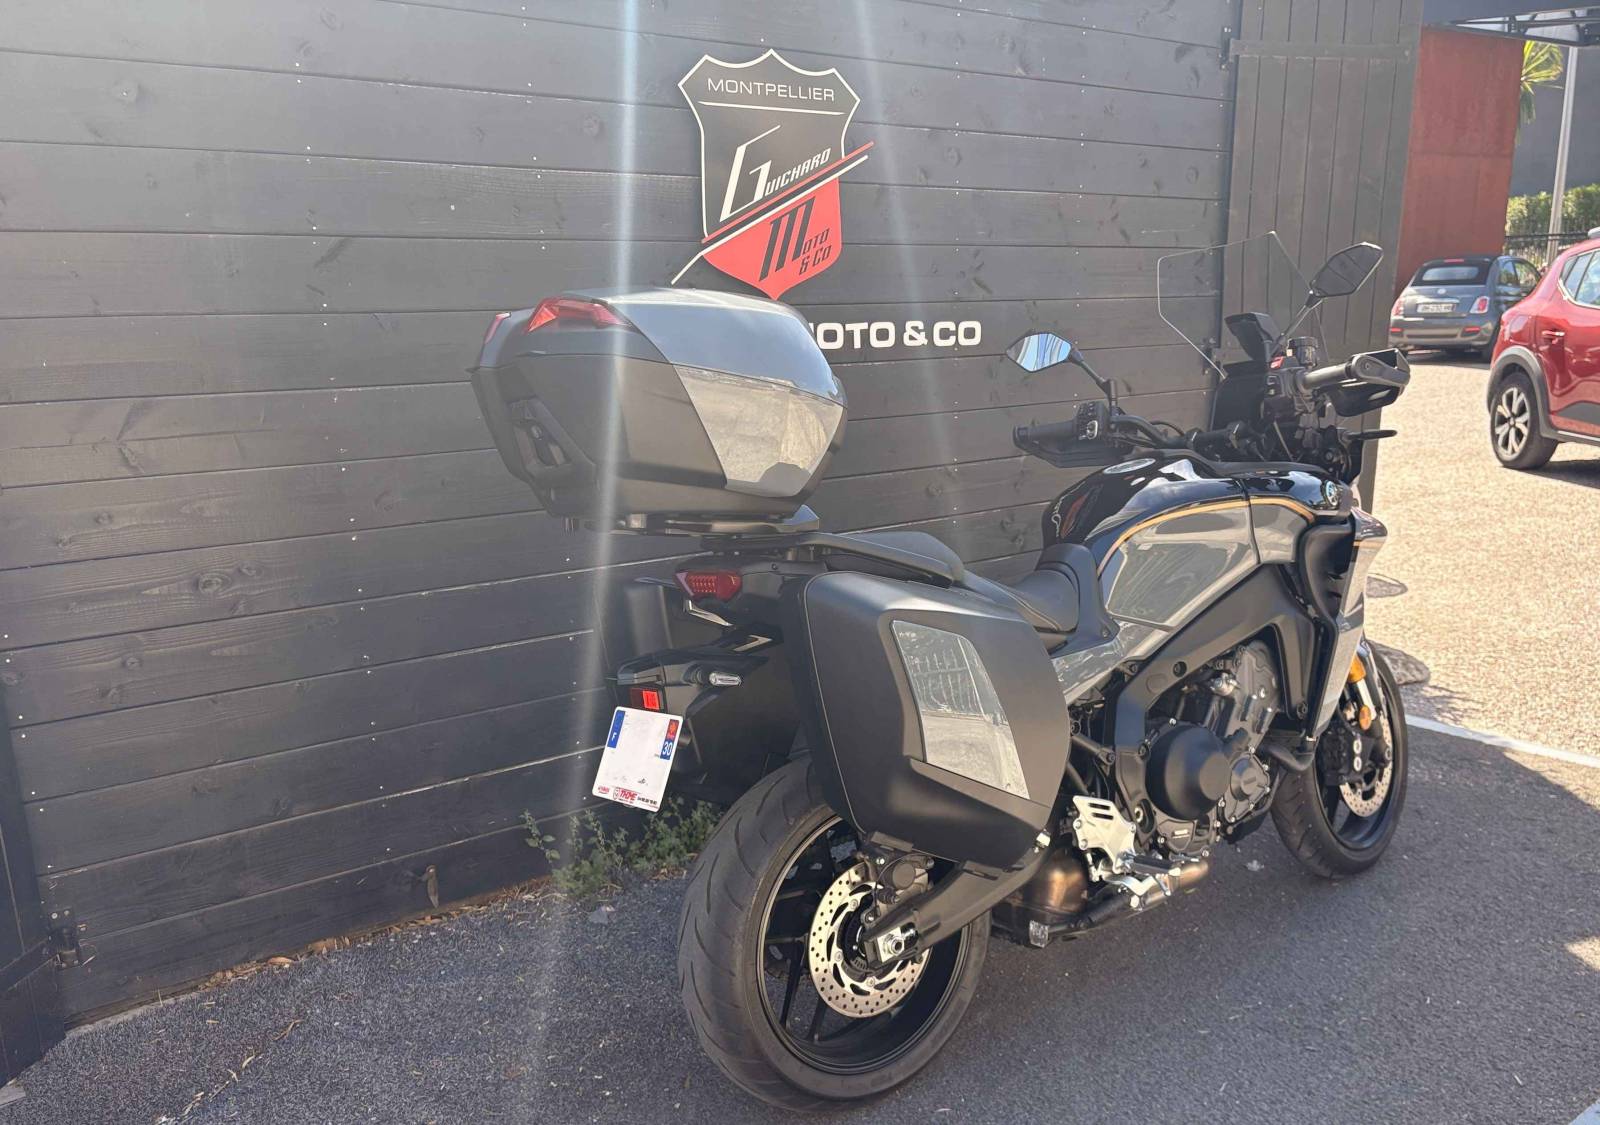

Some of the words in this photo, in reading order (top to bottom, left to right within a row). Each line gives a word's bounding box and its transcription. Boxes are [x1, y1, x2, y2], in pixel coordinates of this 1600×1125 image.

[707, 77, 835, 101] MONTPELLIER
[809, 321, 896, 350] OTO
[903, 320, 929, 347] &
[933, 320, 982, 347] CO
[662, 741, 673, 756] 30
